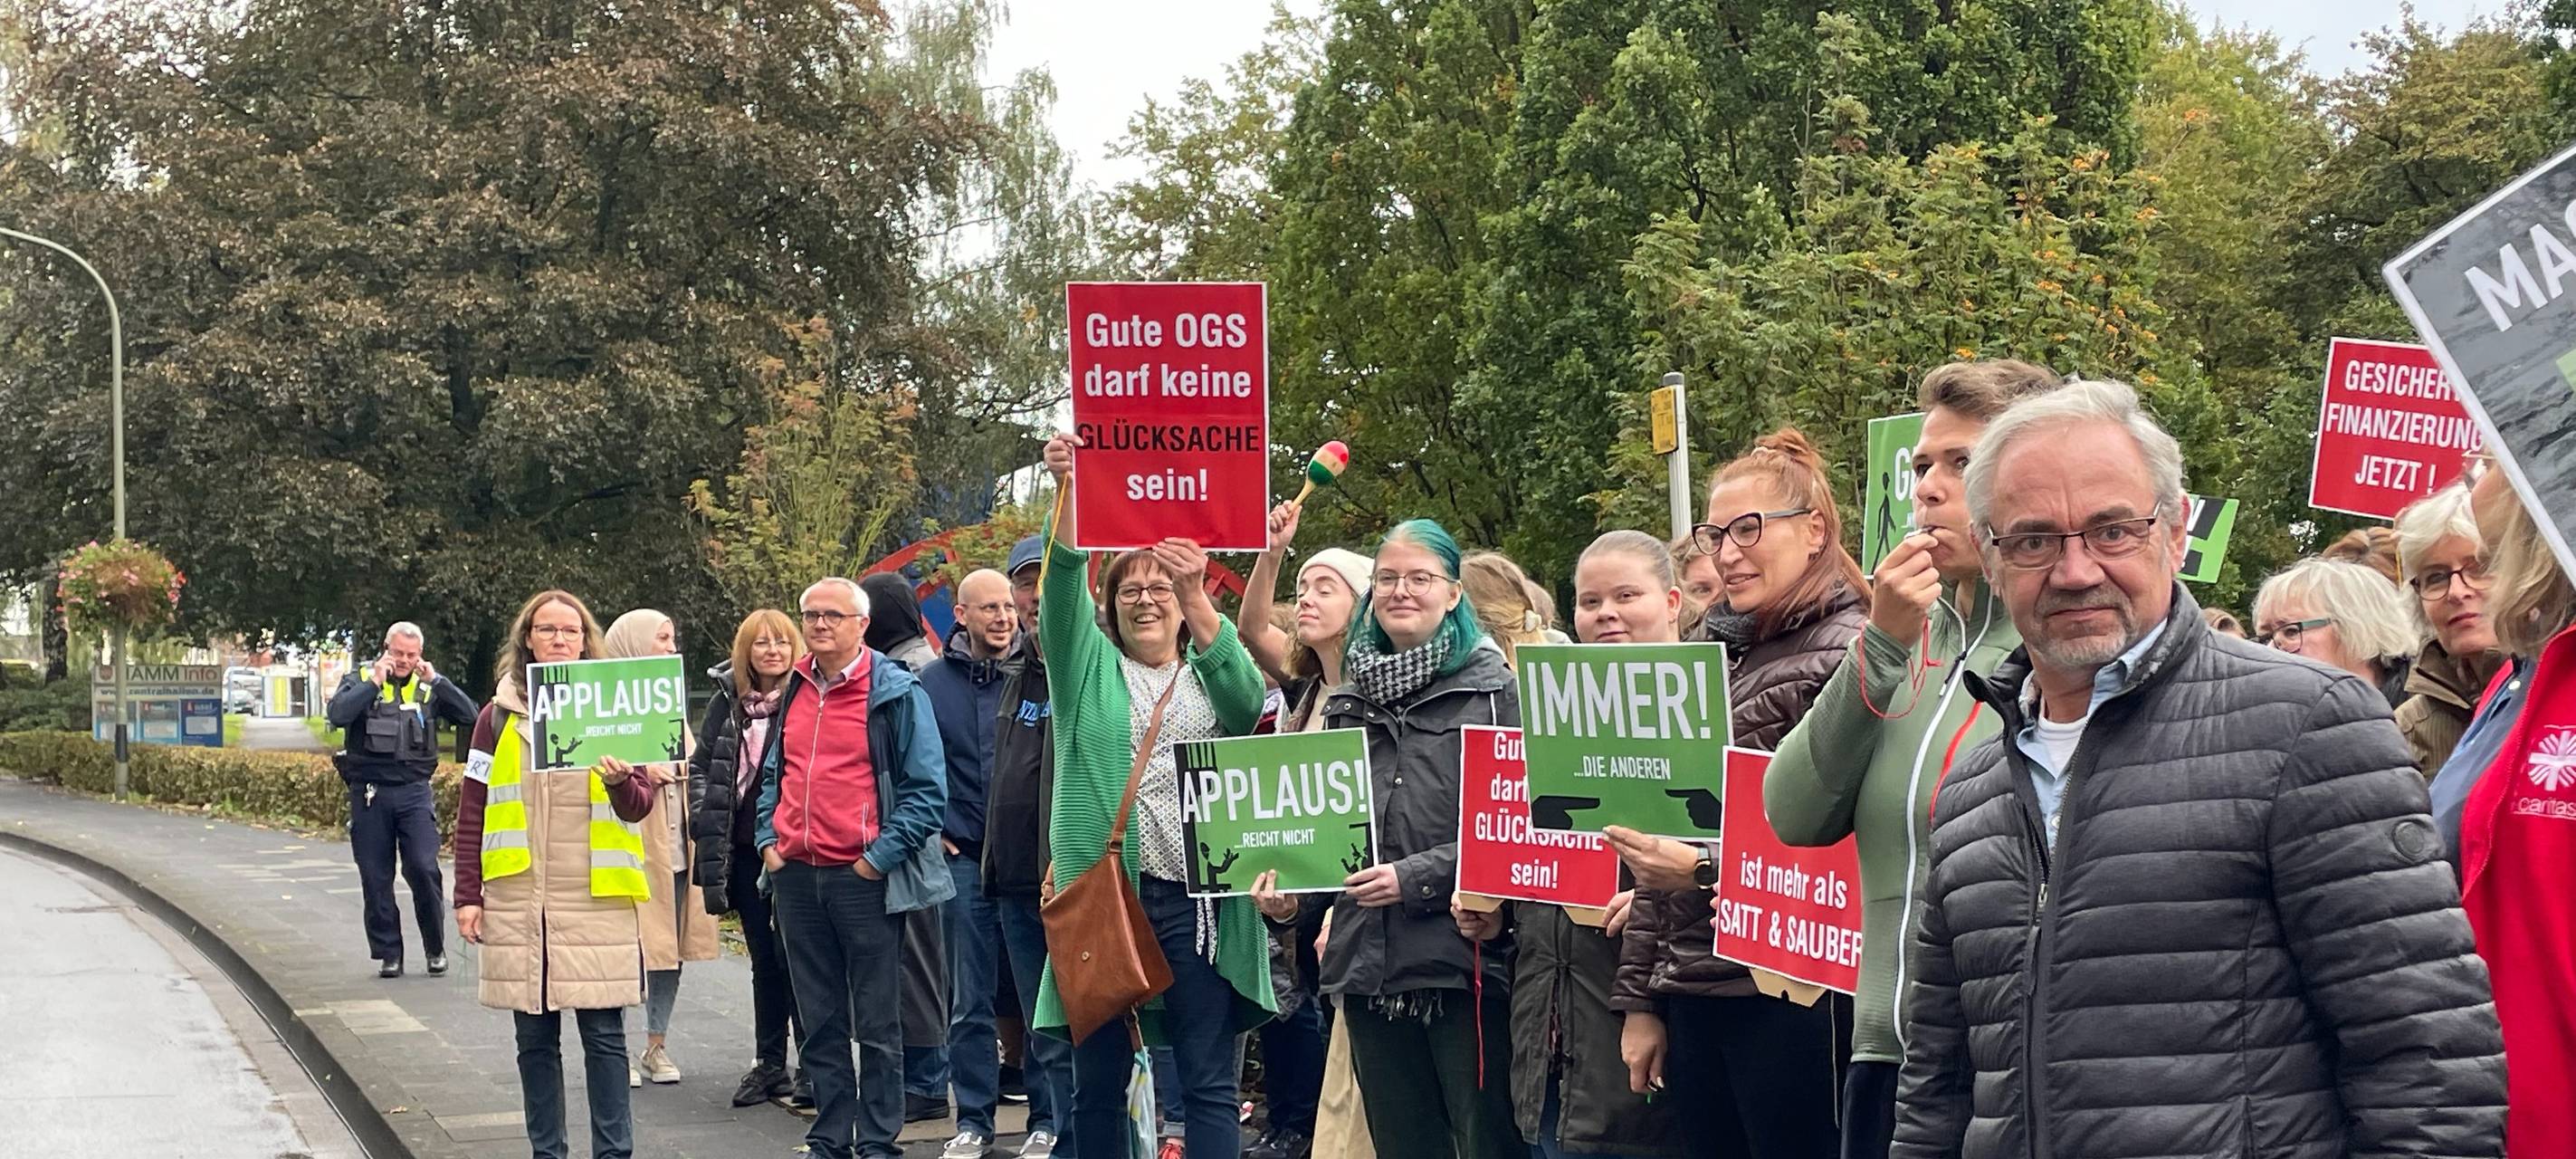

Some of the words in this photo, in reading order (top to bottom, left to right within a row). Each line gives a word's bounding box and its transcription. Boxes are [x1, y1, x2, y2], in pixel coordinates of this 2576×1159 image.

[2465, 198, 2576, 332] MA
[1085, 312, 1162, 348] Gute
[1176, 312, 1247, 348] OGS
[1084, 363, 1150, 397] darf
[1160, 363, 1252, 398] keine
[2344, 359, 2462, 402] GESICHER
[1075, 418, 1260, 452] GLÜCKSACHE
[2325, 403, 2484, 452] FINANZIERUNG
[1126, 467, 1208, 501] sein!
[2354, 455, 2422, 492] JETZT
[184, 667, 217, 680] Info
[533, 676, 682, 723] APPLAUS!
[1526, 661, 1712, 739] IMMER!
[617, 723, 643, 735] NICHT
[1493, 732, 1526, 761] Gut
[1573, 755, 1607, 777] ...DIE
[1610, 757, 1671, 780] ANDEREN
[1182, 759, 1365, 823] APPLAUS!
[2518, 797, 2576, 818] caritas
[1234, 830, 1279, 848] ...REICHT
[1283, 829, 1314, 846] NICHT
[1510, 859, 1559, 889] sein!
[1740, 852, 1763, 889] ist
[1766, 863, 1810, 900] mehr
[1813, 871, 1847, 909] als
[1720, 898, 1763, 942] SATT
[1768, 911, 1782, 948] &
